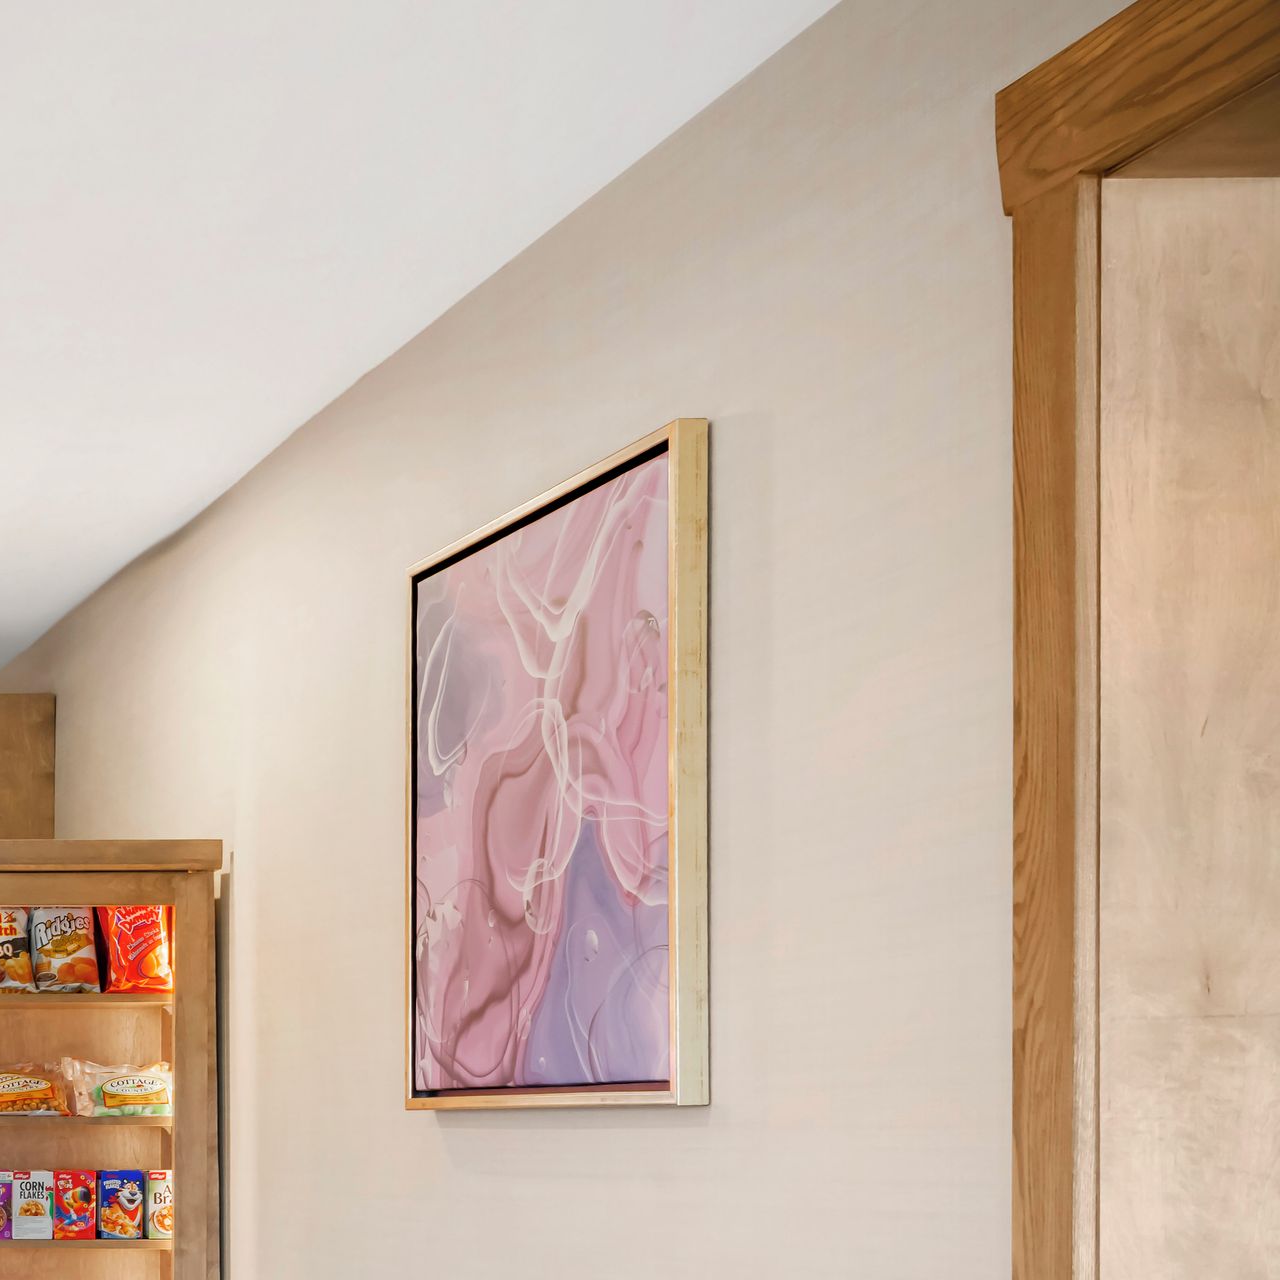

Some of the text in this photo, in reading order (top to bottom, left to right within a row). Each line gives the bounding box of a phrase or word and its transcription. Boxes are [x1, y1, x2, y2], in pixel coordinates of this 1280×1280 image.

[34, 912, 90, 950] Ridgies
[110, 1078, 156, 1088] COTTAGE
[19, 1181, 45, 1191] CORN
[19, 1190, 45, 1200] FLAKES
